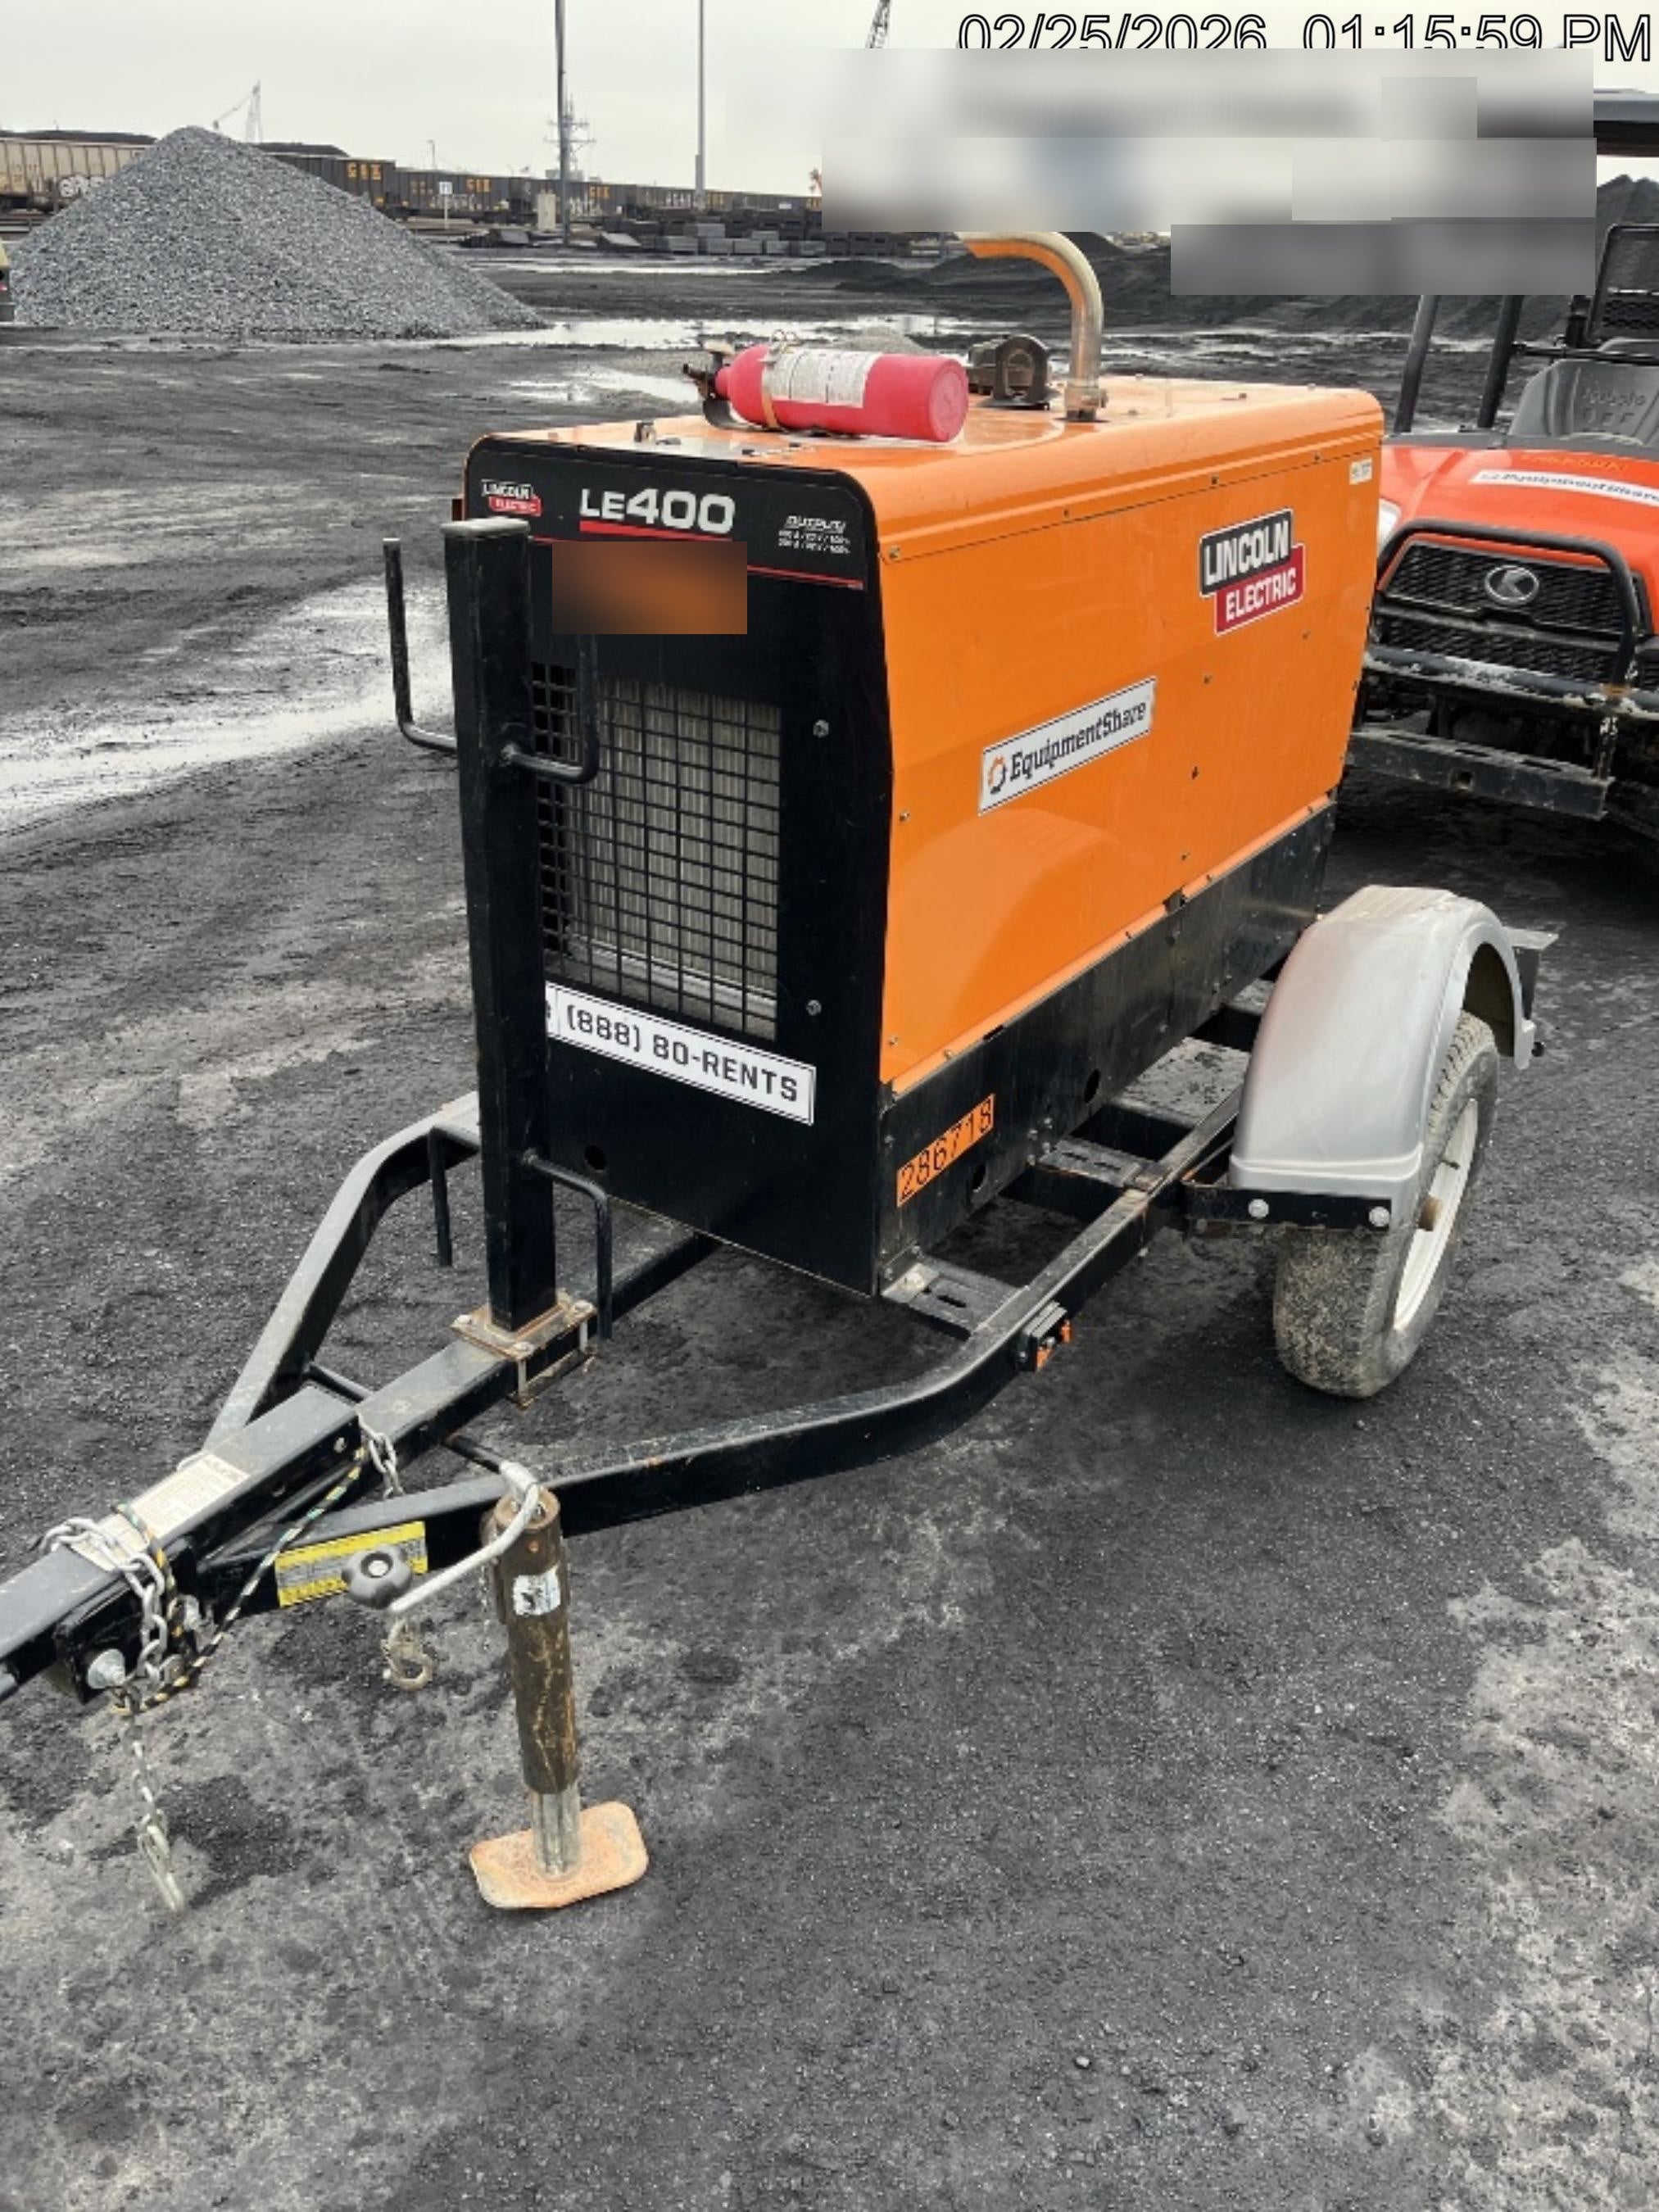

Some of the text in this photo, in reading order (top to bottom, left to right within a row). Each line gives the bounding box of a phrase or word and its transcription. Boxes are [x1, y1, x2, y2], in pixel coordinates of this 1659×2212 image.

[580, 487, 736, 534] LE400
[1204, 520, 1290, 587] LINCOLN
[1225, 567, 1297, 623] ELECTRIC
[1009, 702, 1147, 782] EquipmentShare
[567, 1004, 798, 1102] (888) 80-RENTS
[900, 1098, 990, 1201] 286718
